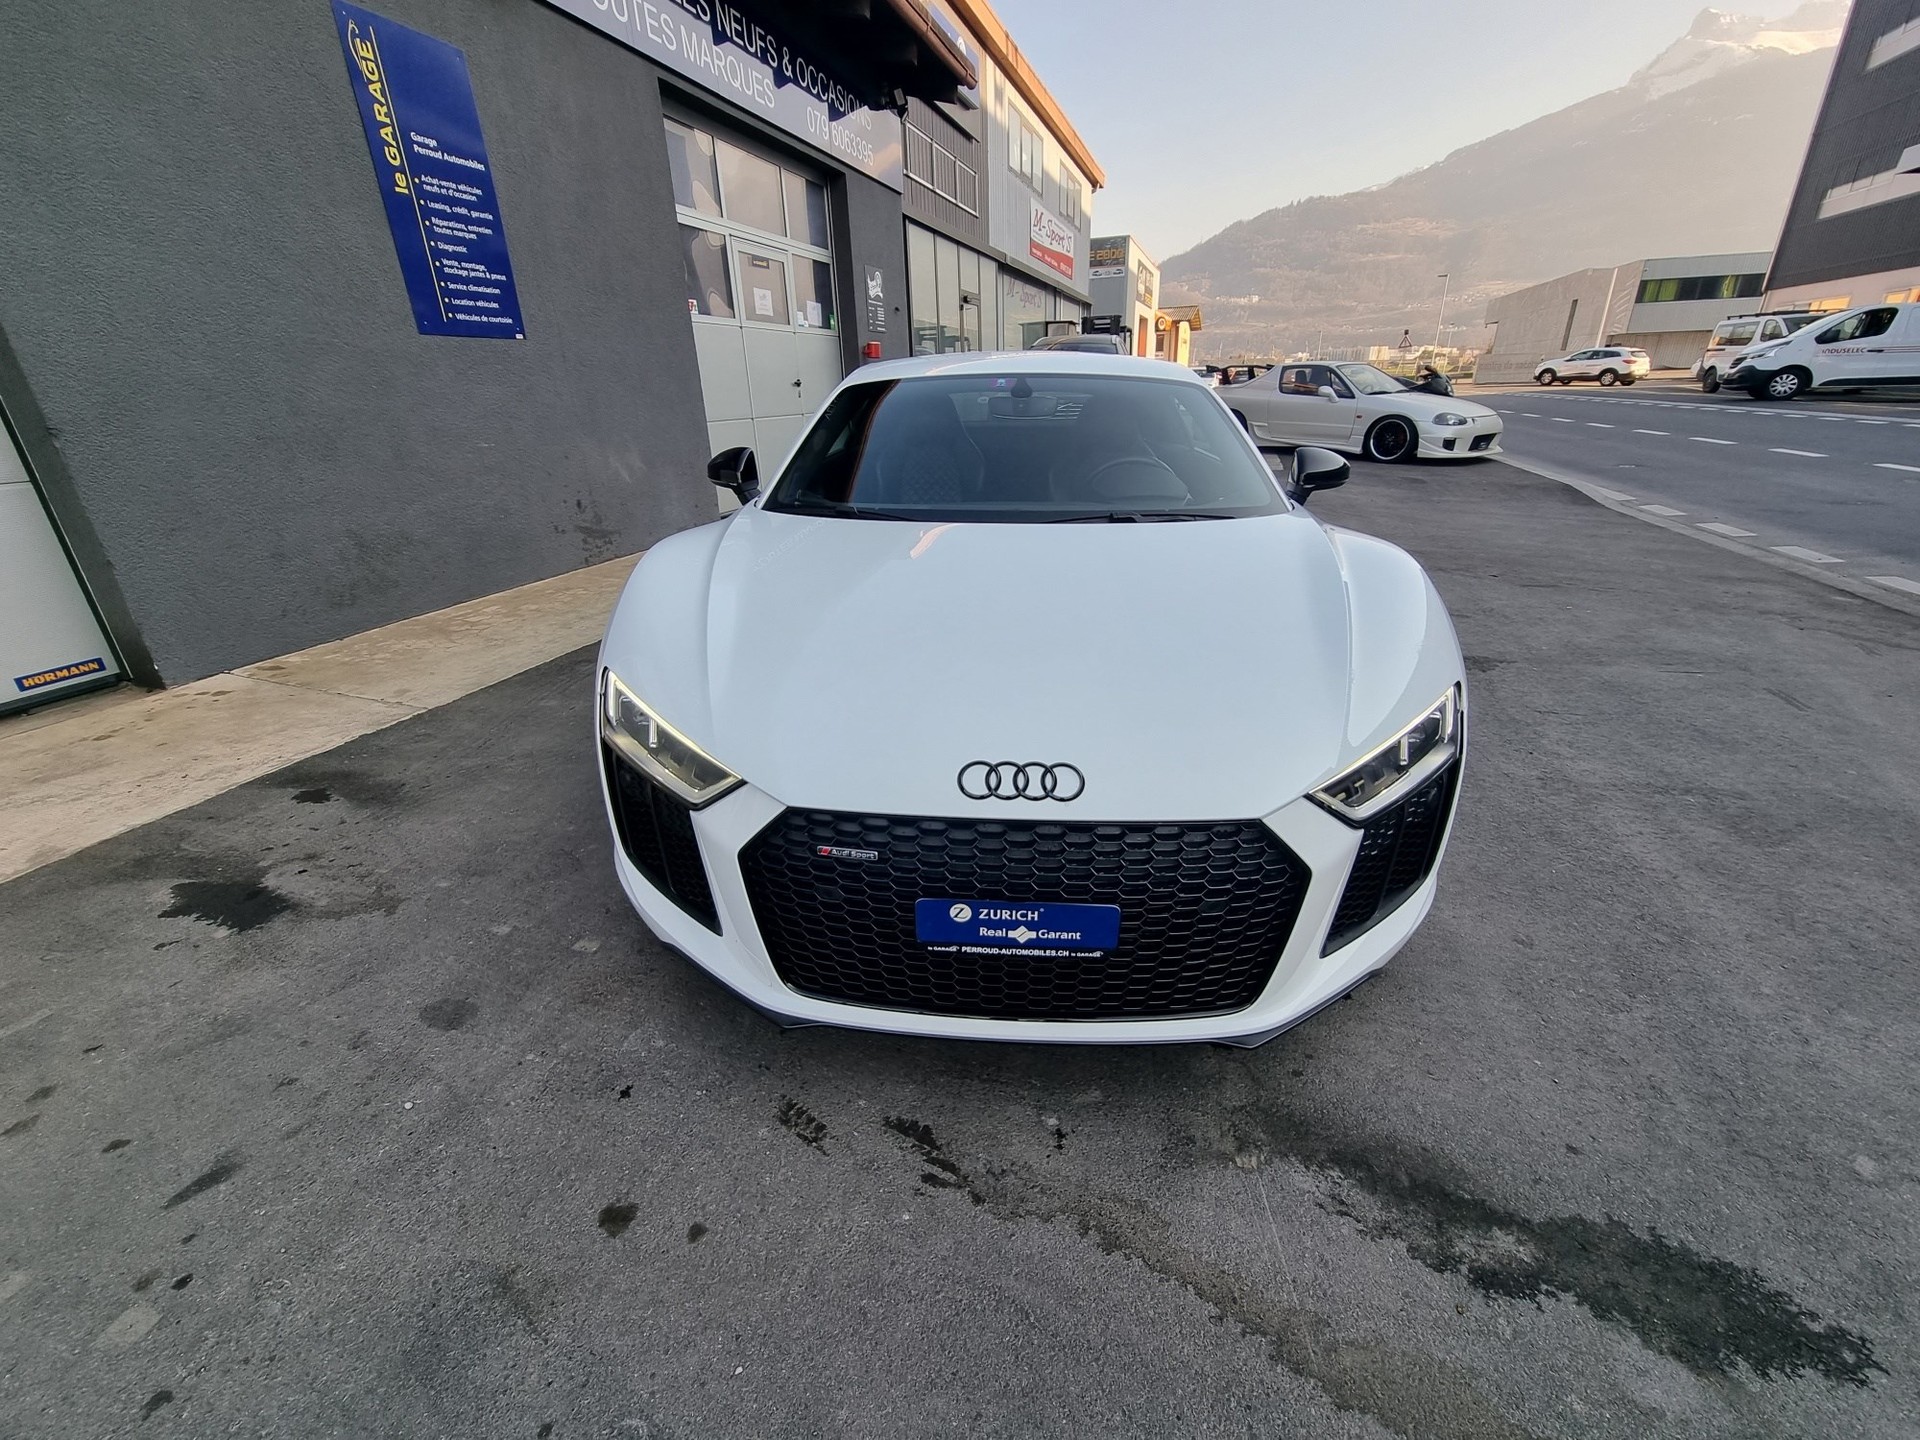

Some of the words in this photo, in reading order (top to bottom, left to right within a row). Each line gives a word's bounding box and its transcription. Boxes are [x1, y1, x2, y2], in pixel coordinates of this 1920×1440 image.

[680, 25, 775, 109] MARQUES
[715, 0, 779, 68] NEUFS
[782, 46, 793, 79] &
[796, 57, 872, 131] OCCASIONS
[354, 37, 401, 167] GARAGE
[410, 131, 438, 148] Garage
[807, 106, 829, 140] 079
[831, 122, 874, 166] 6063395
[413, 144, 443, 160] Perroud
[443, 152, 486, 171] Automobiles
[394, 172, 409, 194] le
[421, 174, 457, 190] Achat-vente
[457, 183, 483, 196] véhicules
[437, 241, 468, 253] Diagnostic
[447, 281, 467, 292] Service
[451, 297, 476, 307] Location
[475, 300, 500, 309] véhicules
[455, 312, 481, 322] Véhicules
[481, 314, 488, 323] de
[831, 849, 850, 857] Audi
[850, 850, 875, 859] Sport
[978, 908, 1039, 922] ZURICH
[979, 926, 1007, 938] Real
[1038, 929, 1081, 941] Garant
[961, 946, 1069, 957] PERROUD-AUTOMOBILES.CH
